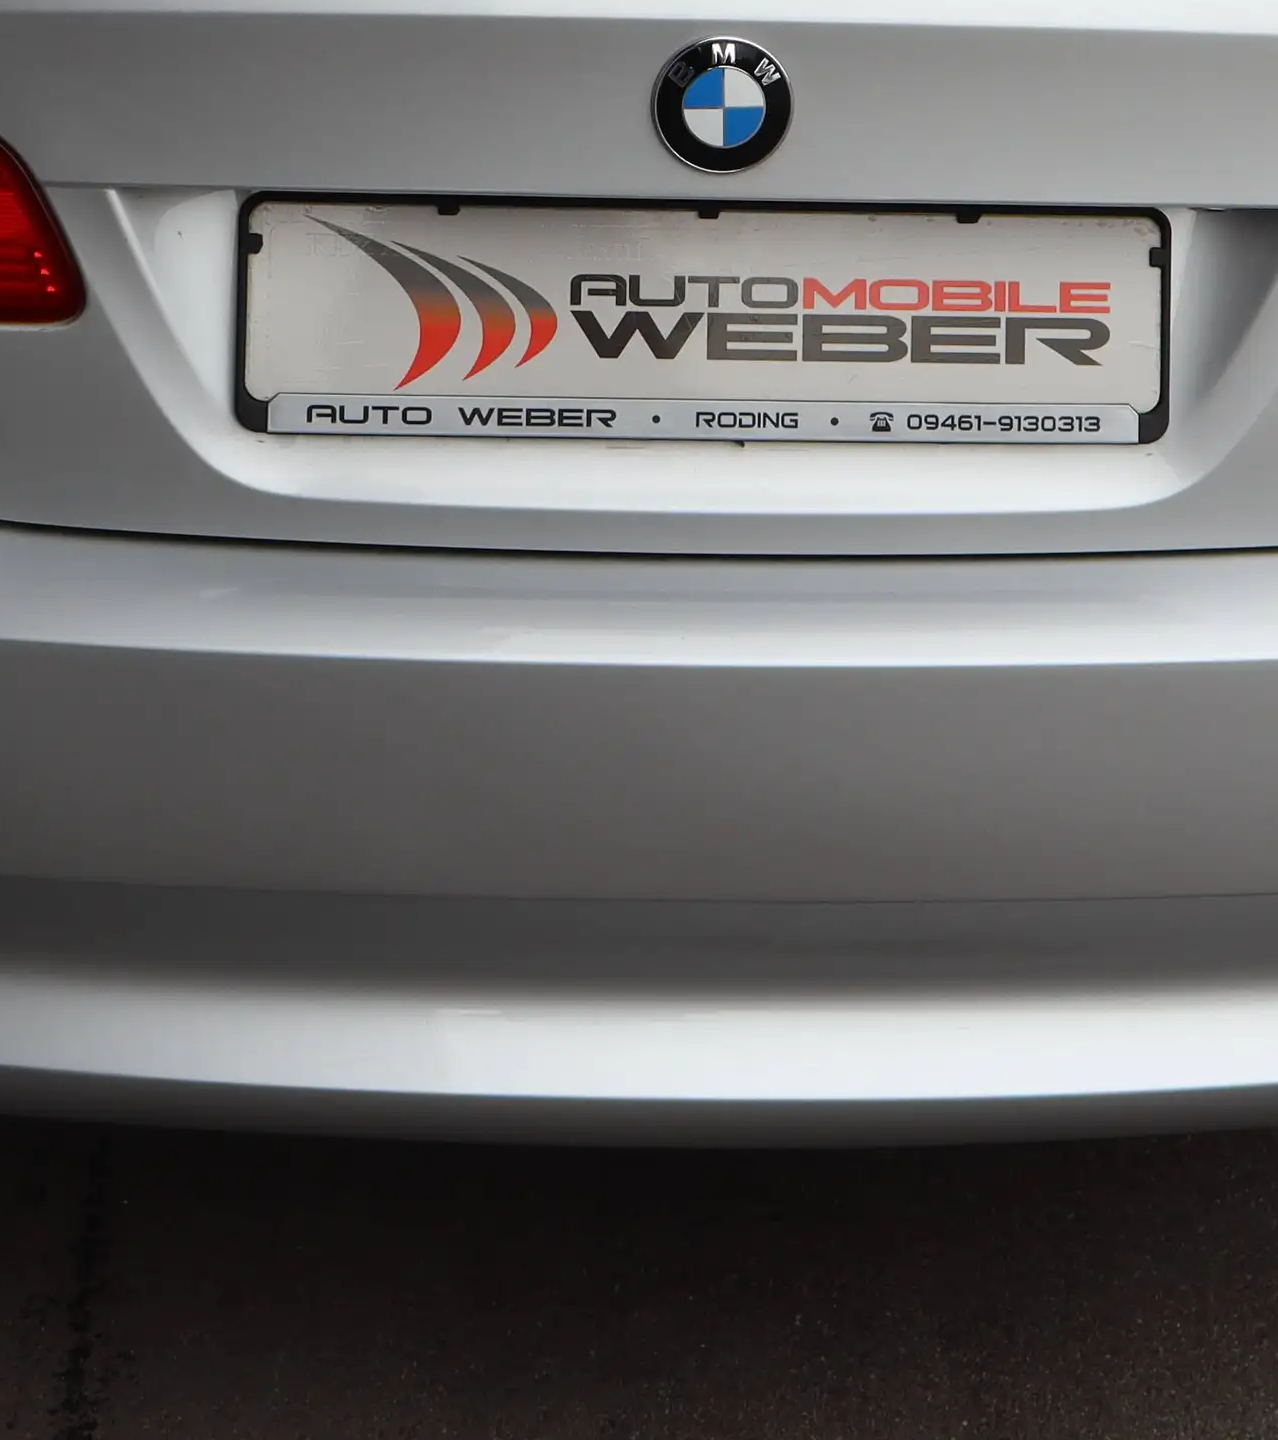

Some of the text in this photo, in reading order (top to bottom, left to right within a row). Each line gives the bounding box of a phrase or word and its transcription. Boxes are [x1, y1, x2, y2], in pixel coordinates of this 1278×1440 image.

[668, 42, 781, 88] BMW
[569, 273, 1112, 314] AUTOMOBILE
[569, 309, 1112, 367] WEBER
[305, 404, 1102, 433] AUTO WEBER RODING 09461-9130313
